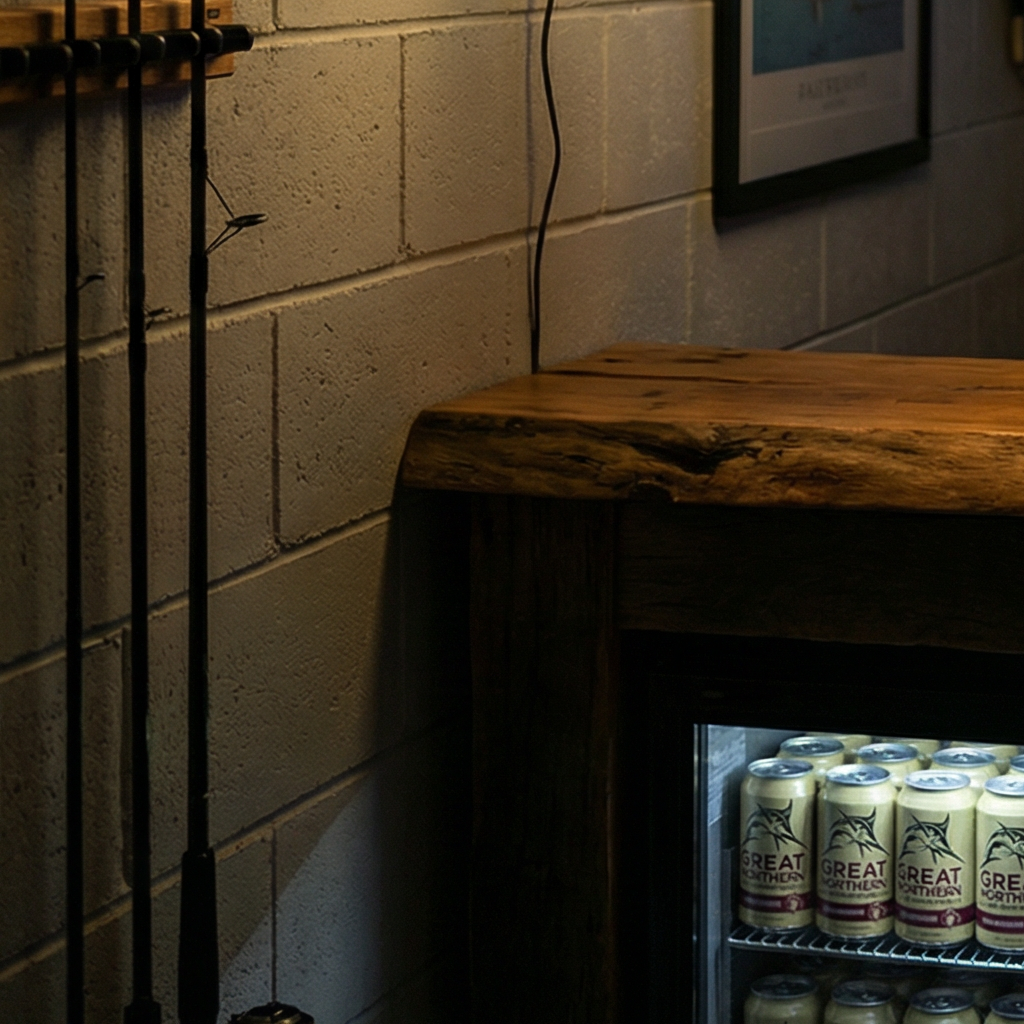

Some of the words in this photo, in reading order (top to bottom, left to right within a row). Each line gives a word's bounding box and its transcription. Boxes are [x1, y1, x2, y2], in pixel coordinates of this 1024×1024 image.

[742, 850, 805, 870] GREAT
[821, 858, 887, 879] GREAT
[898, 863, 962, 885] GREAT
